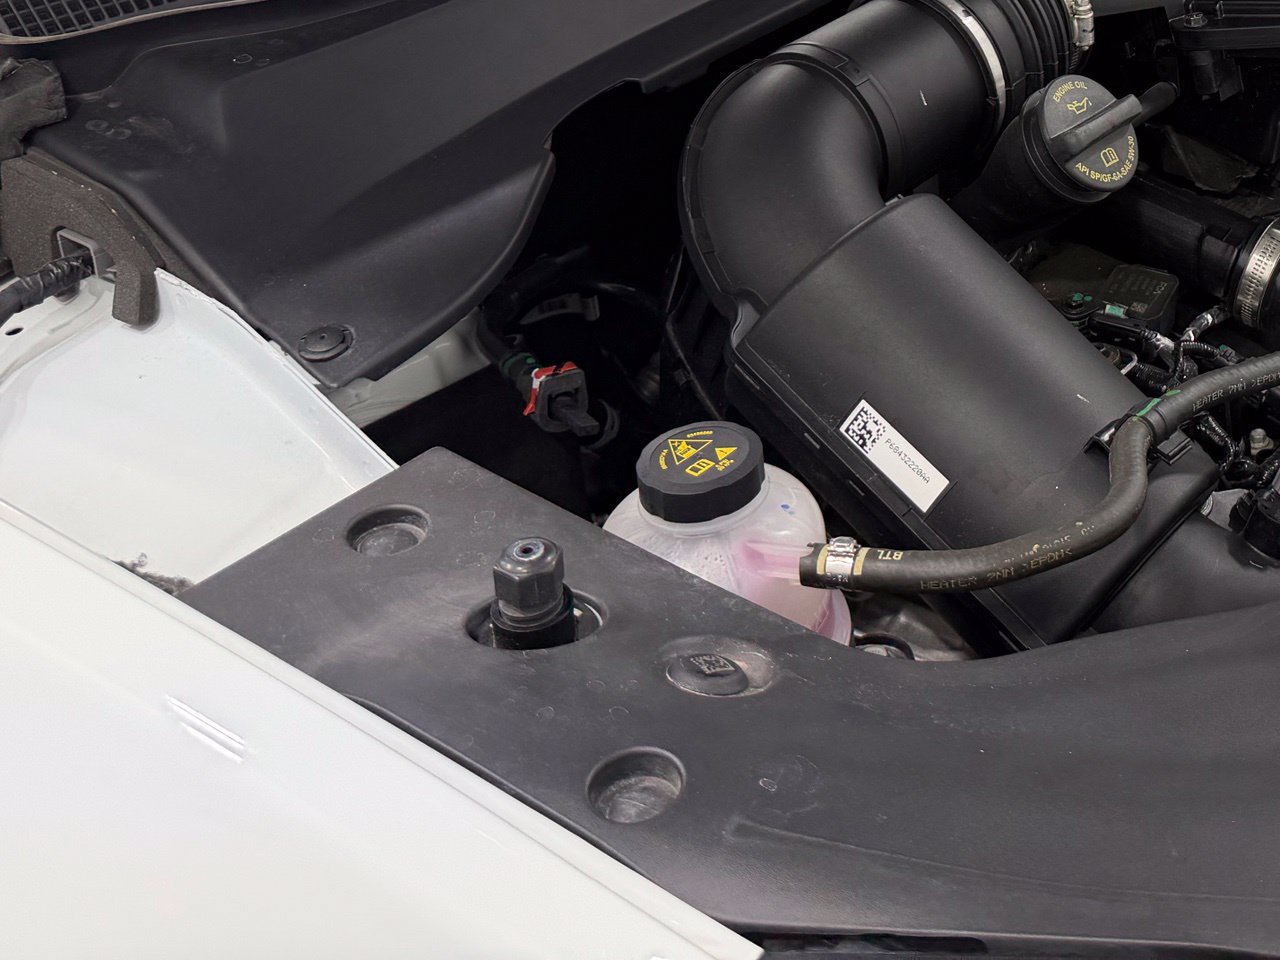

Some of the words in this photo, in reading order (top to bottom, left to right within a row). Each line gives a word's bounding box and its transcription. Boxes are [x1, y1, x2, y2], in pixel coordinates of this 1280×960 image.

[1052, 81, 1075, 102] ENGINE
[1075, 80, 1088, 90] OIL
[1075, 162, 1090, 176] API
[1127, 135, 1135, 161] 5W-30
[877, 549, 904, 561] BTL
